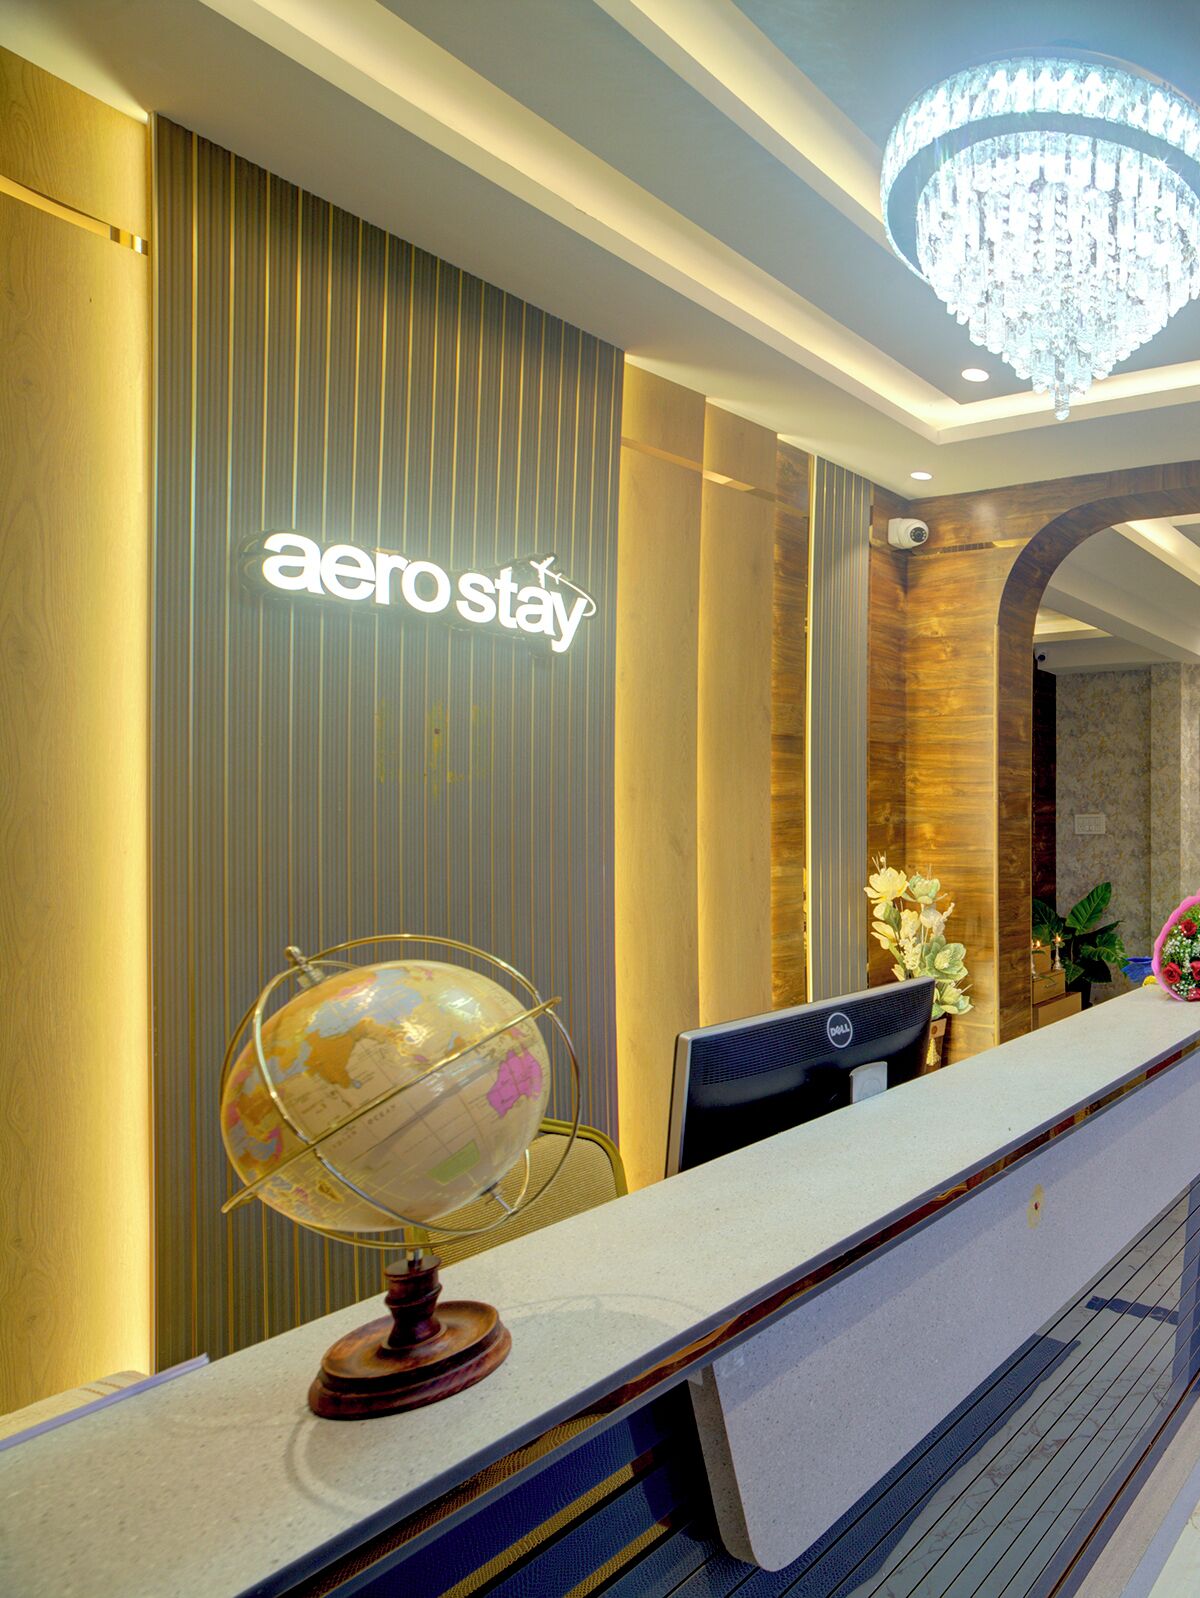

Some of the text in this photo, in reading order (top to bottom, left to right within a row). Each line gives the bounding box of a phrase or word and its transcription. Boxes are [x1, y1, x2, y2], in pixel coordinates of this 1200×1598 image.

[262, 532, 588, 653] aero stay
[830, 1023, 850, 1037] DELL
